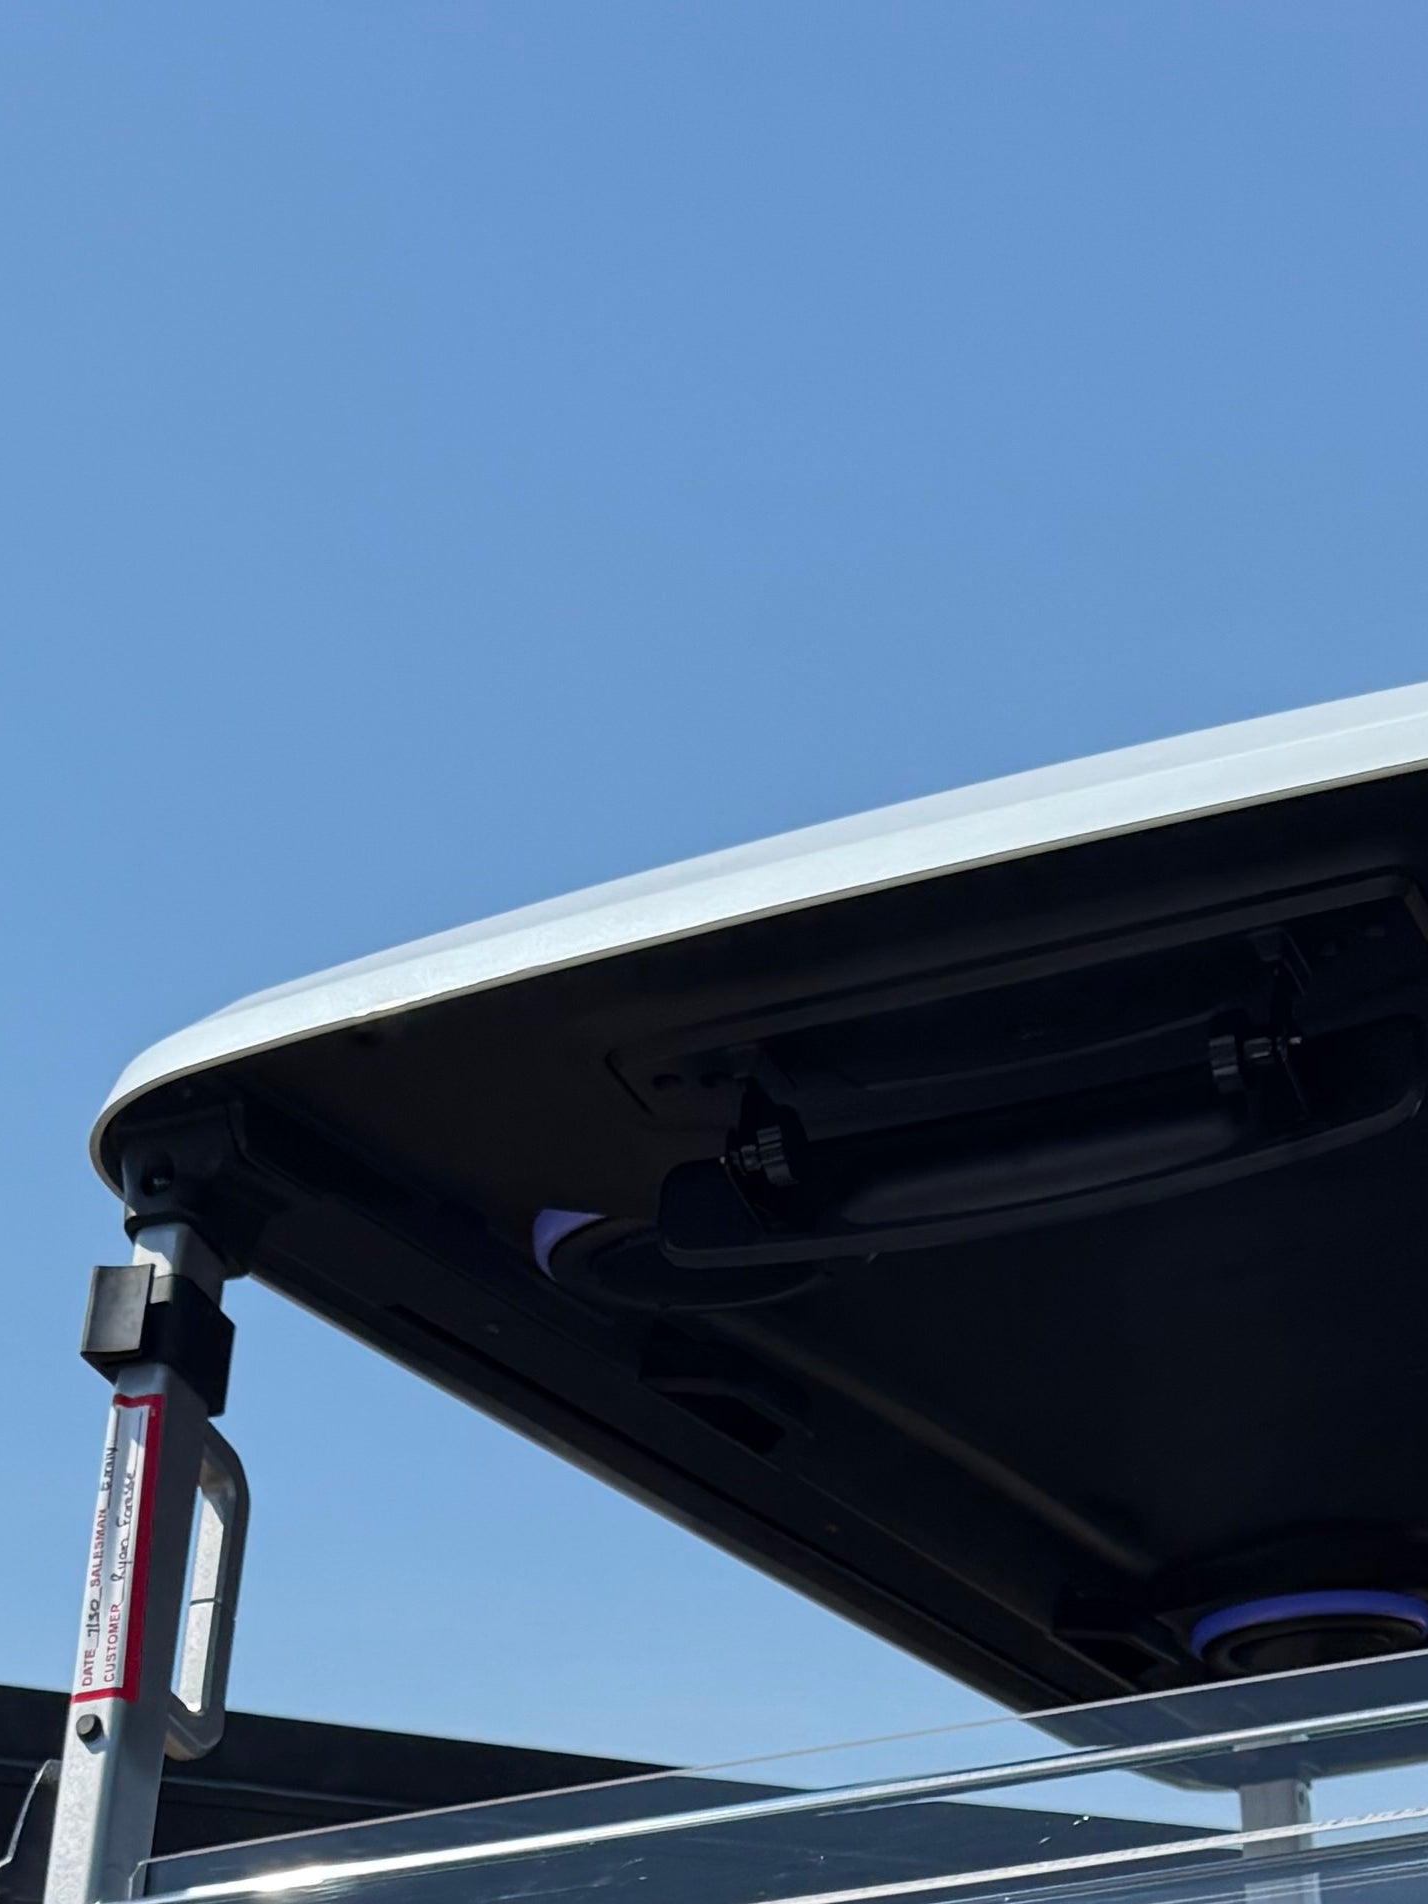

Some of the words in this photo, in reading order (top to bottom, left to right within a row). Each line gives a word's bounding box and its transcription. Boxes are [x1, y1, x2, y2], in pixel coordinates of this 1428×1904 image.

[81, 1648, 97, 1687] DATE
[90, 1508, 108, 1587] SALESMAN
[103, 1603, 121, 1683] CUSTOMER
